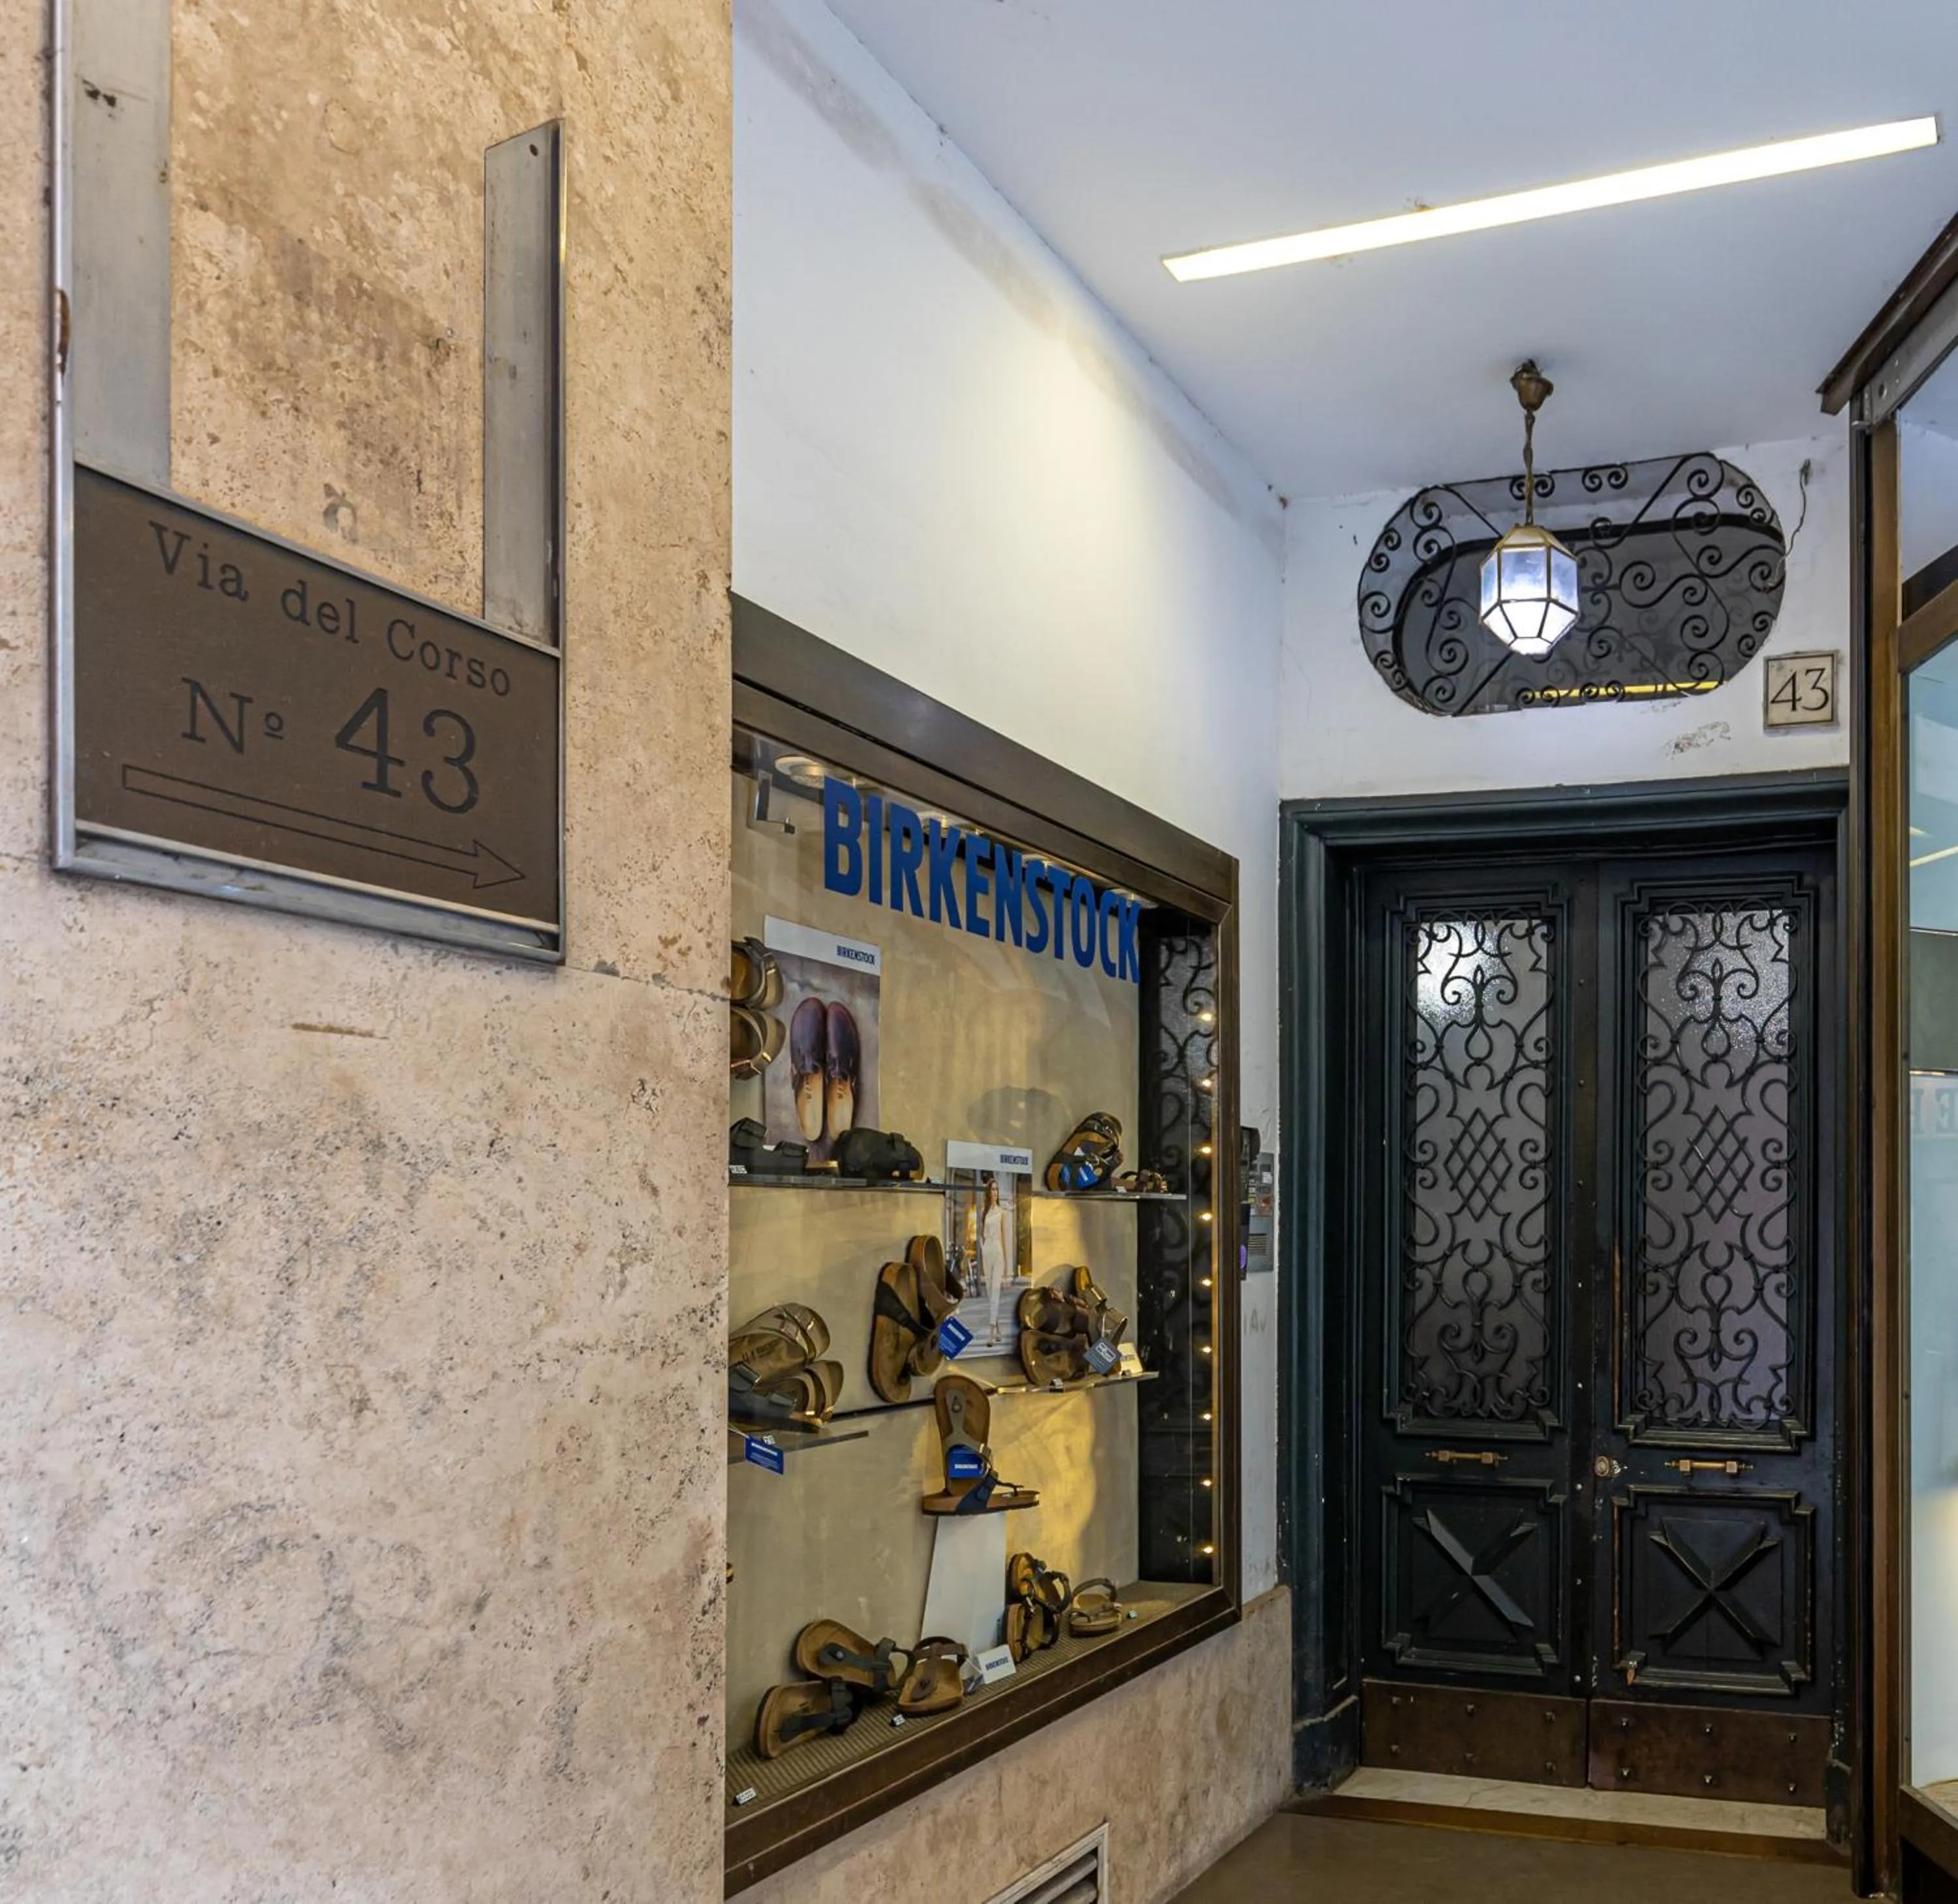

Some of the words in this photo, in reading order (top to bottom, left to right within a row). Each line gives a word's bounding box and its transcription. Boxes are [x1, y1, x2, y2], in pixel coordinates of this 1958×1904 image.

[149, 521, 248, 602] Via
[280, 581, 359, 643] del
[387, 619, 510, 696] Corso
[335, 686, 479, 814] 43
[1771, 668, 1829, 711] 43
[824, 776, 1140, 983] BIRKENSTOCK
